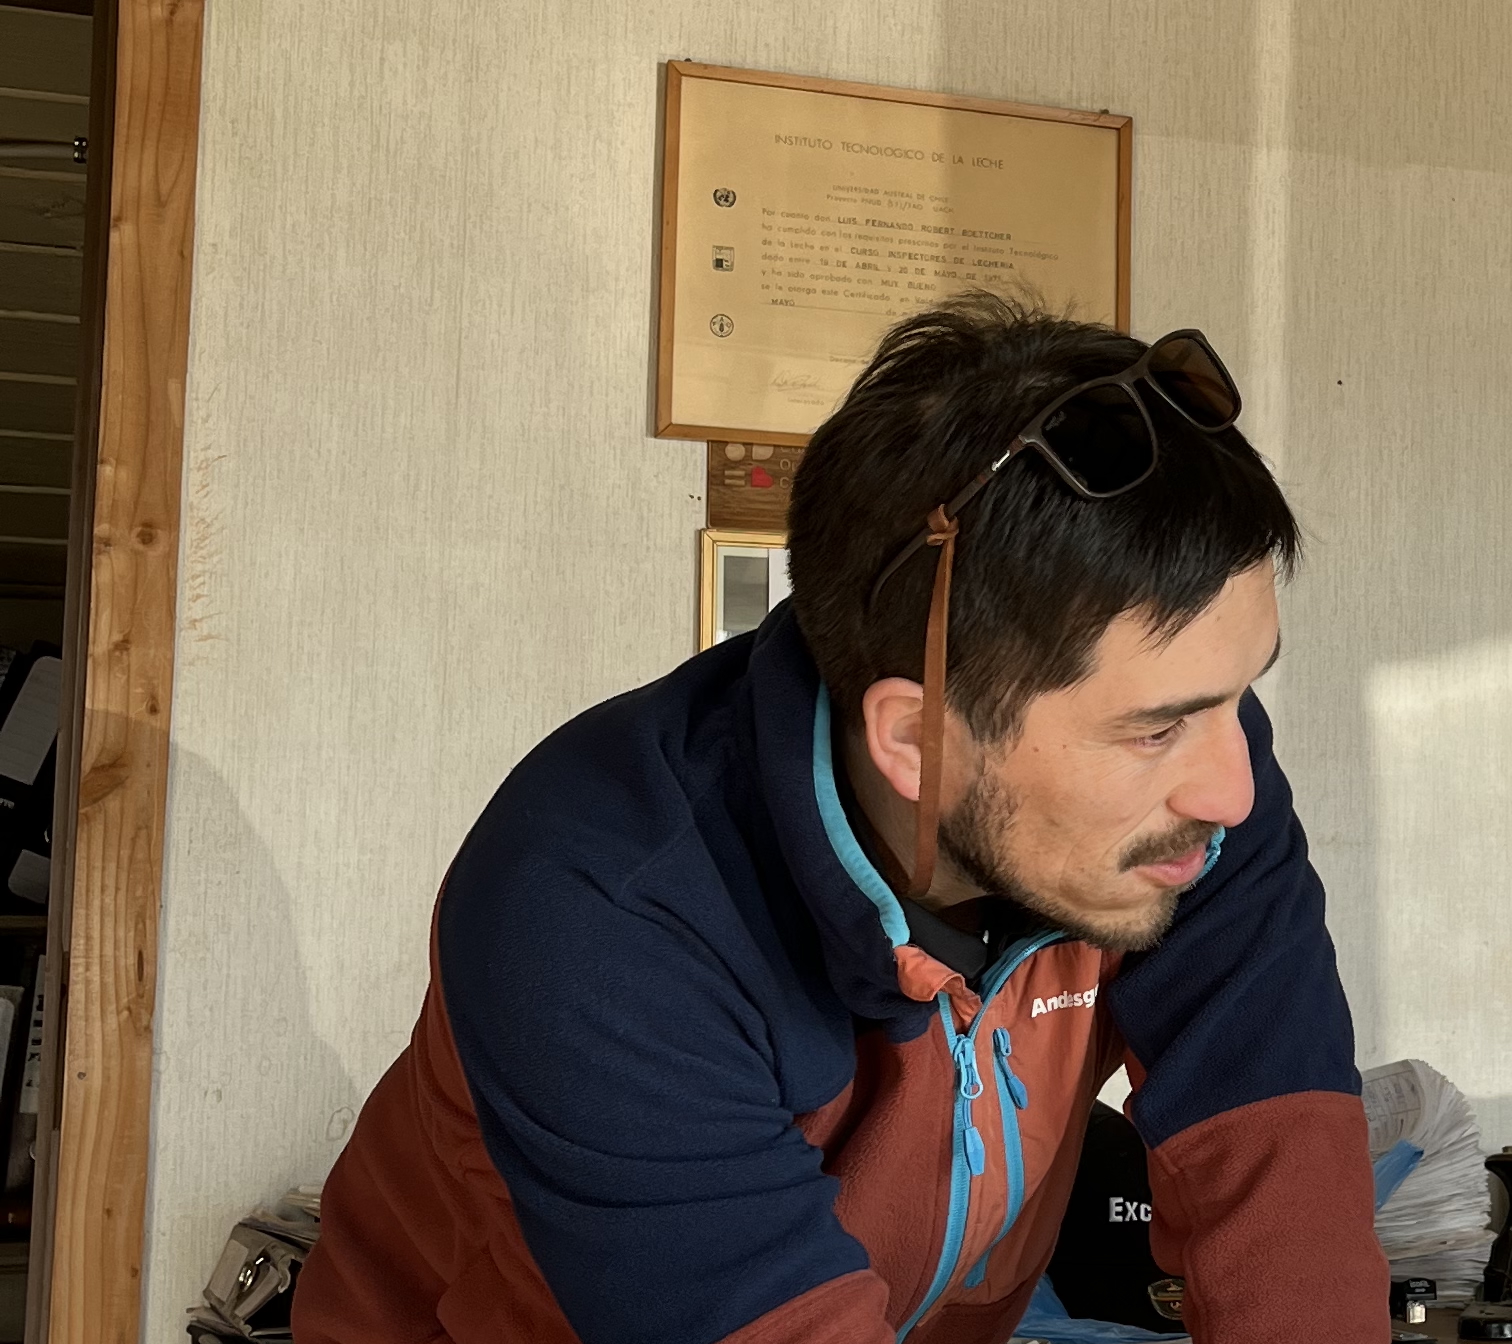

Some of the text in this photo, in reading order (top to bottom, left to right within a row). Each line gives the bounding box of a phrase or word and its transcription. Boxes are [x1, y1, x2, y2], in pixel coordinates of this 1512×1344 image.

[775, 135, 1004, 169] INSTITUTO TECNOLOGICO DE LA LECHE
[762, 208, 776, 217] Por
[814, 213, 830, 222] don
[838, 216, 857, 226] LUIS
[865, 219, 913, 231] FERNANDO
[920, 224, 955, 236] ROBERT
[836, 260, 848, 269] DE
[914, 267, 926, 276] DE
[934, 270, 957, 279] MAYO
[850, 247, 879, 257] CURSO
[888, 251, 947, 264] INSPECTORES
[953, 257, 965, 266] DE
[971, 258, 1014, 270] LECHERIA
[771, 298, 795, 307] MAYO
